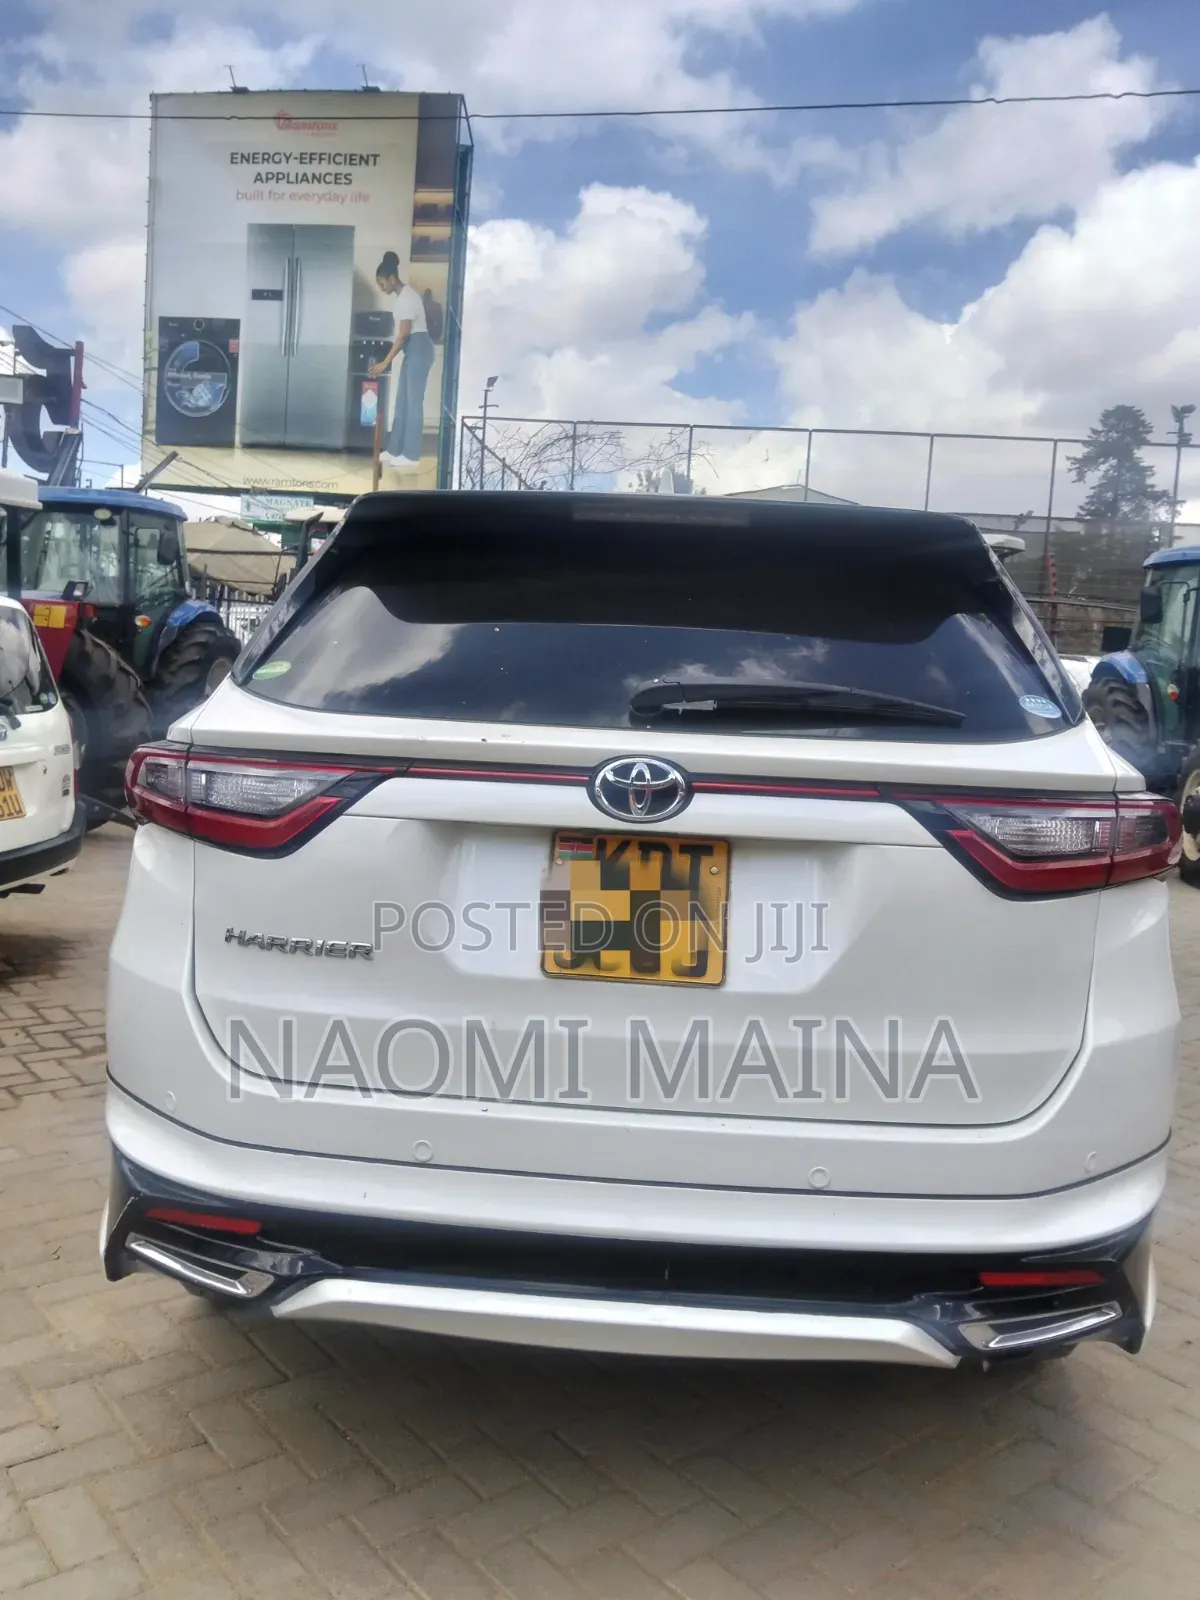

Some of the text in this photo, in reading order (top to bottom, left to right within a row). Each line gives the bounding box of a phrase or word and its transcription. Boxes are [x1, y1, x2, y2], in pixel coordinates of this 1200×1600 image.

[230, 152, 380, 166] ENERGY-EFFICIENT
[253, 172, 353, 185] APPLIANCES
[236, 189, 371, 204] built for everyday life
[225, 927, 374, 961] HARRIER
